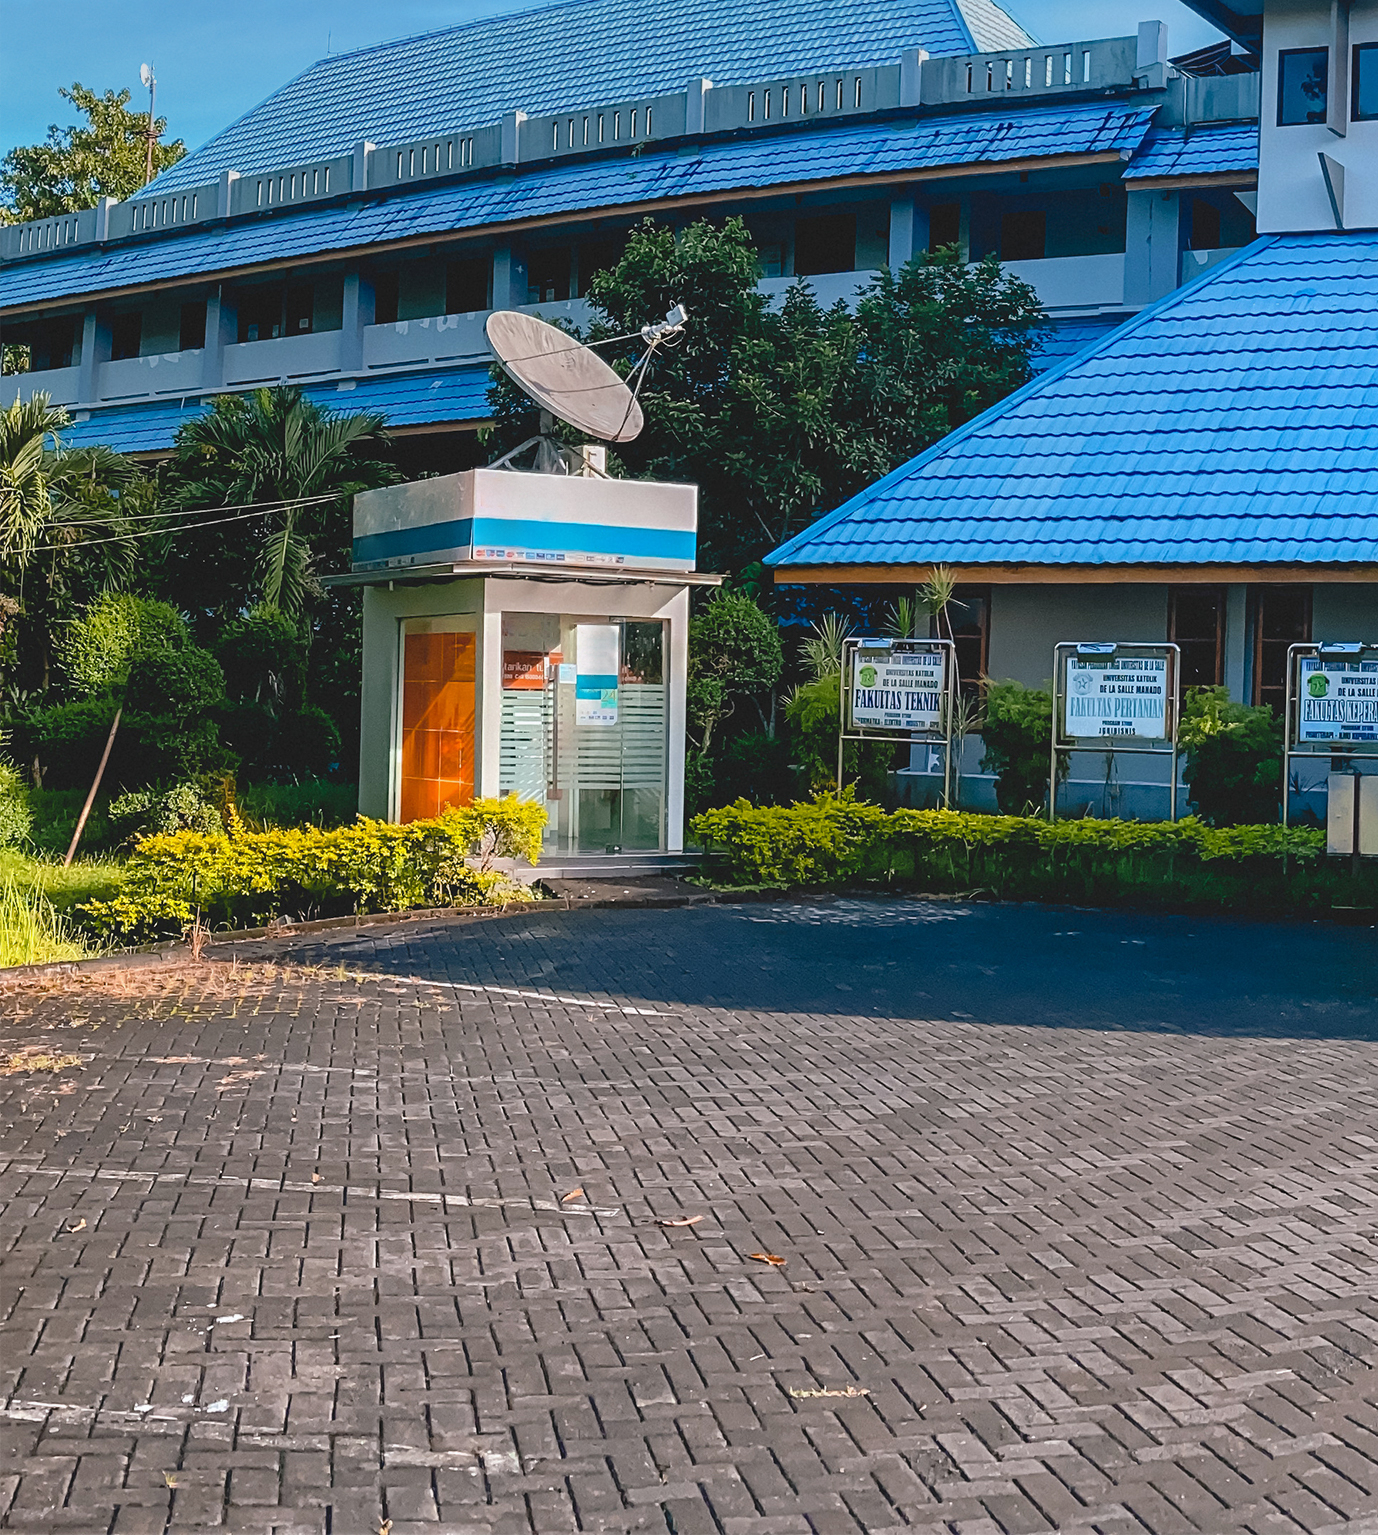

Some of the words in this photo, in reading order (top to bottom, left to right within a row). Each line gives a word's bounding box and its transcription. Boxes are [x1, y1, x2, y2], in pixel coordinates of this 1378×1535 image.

[883, 679, 889, 687] DE
[891, 679, 897, 687] LA
[899, 679, 913, 688] SALLE
[915, 680, 938, 689] MANADO
[1100, 685, 1107, 693] DE
[1109, 685, 1115, 693] LA
[1117, 685, 1134, 694] SALLE
[1136, 686, 1161, 694] MANADO
[1338, 688, 1346, 696] DE
[1348, 688, 1355, 697] LA
[1357, 688, 1375, 697] SALLE
[905, 691, 941, 712] TEKNIK
[1070, 697, 1112, 717] FAKULTAS
[1114, 698, 1164, 718] PERTANIAN
[1304, 699, 1345, 722] FAKULTAS
